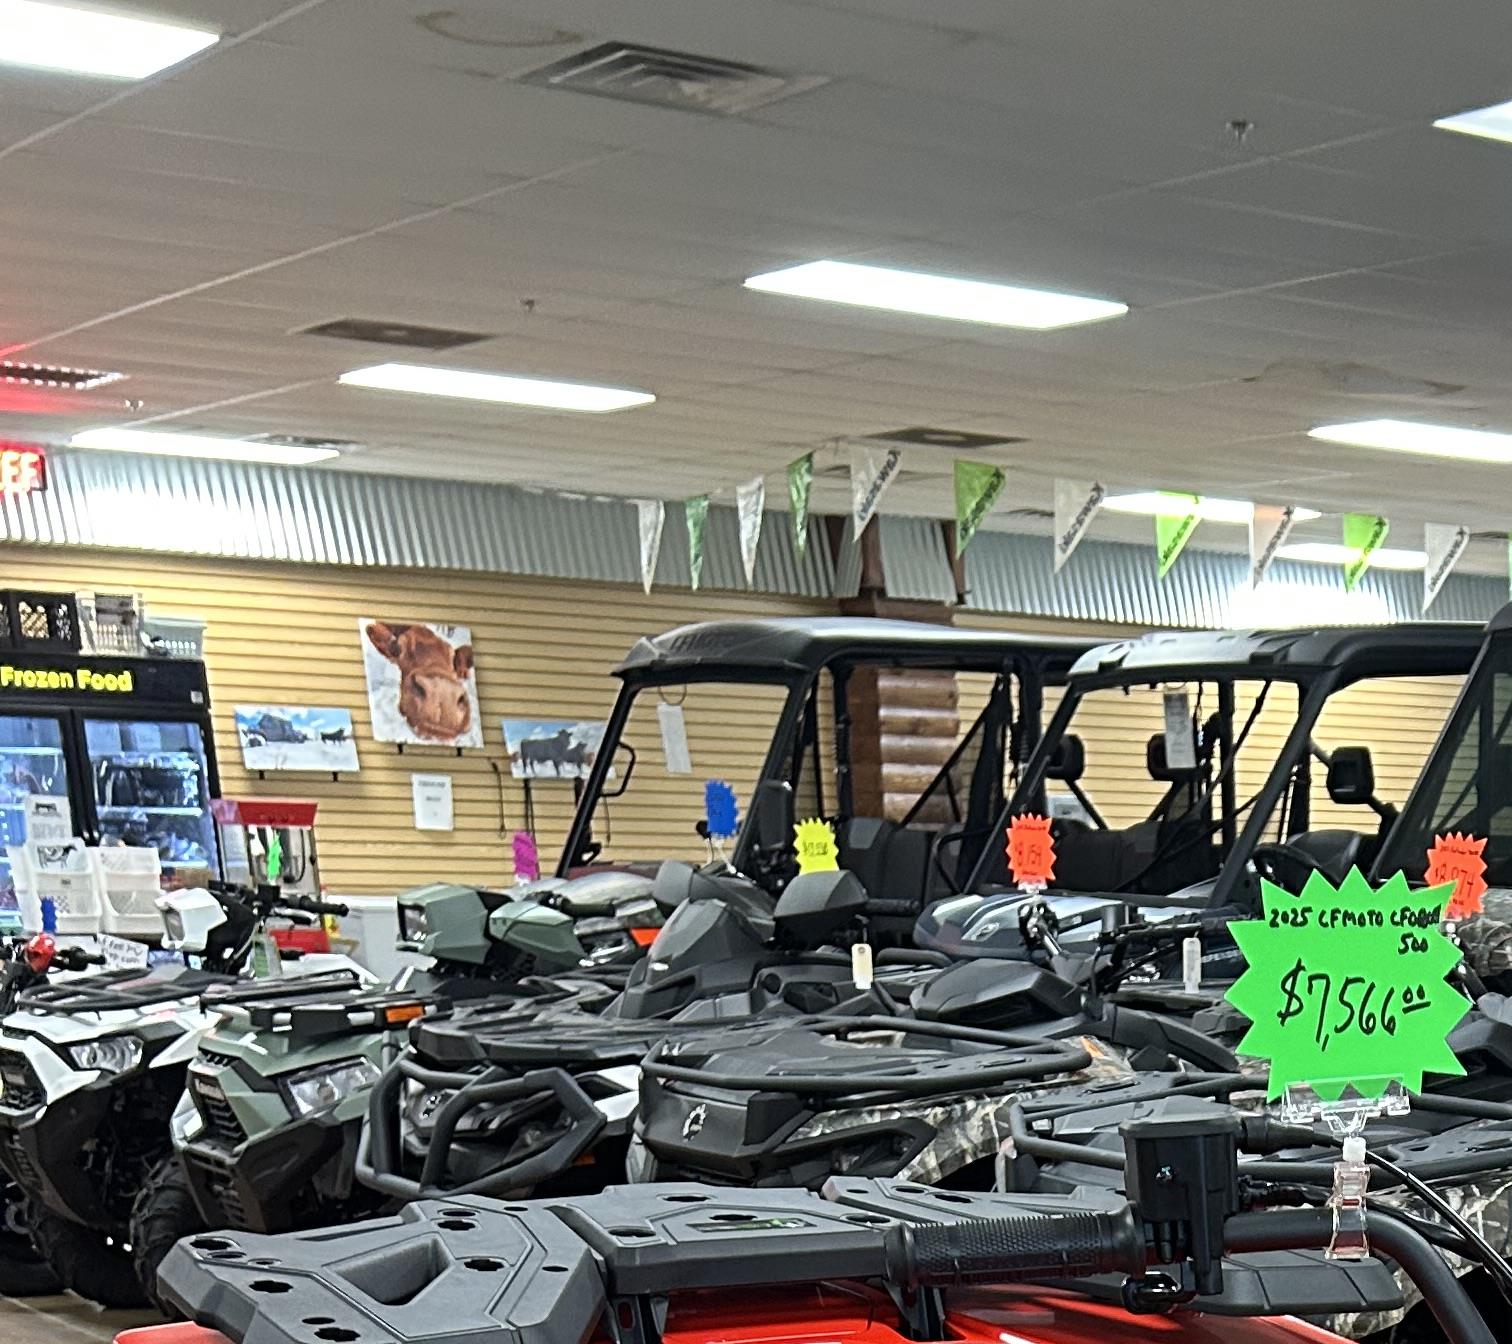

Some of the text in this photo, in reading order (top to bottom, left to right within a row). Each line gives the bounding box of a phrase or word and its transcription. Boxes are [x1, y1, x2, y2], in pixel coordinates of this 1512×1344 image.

[1, 666, 133, 692] Frozen Food
[1269, 907, 1313, 928] 2025
[1318, 908, 1384, 928] CFMOTO
[1398, 931, 1429, 955] 500
